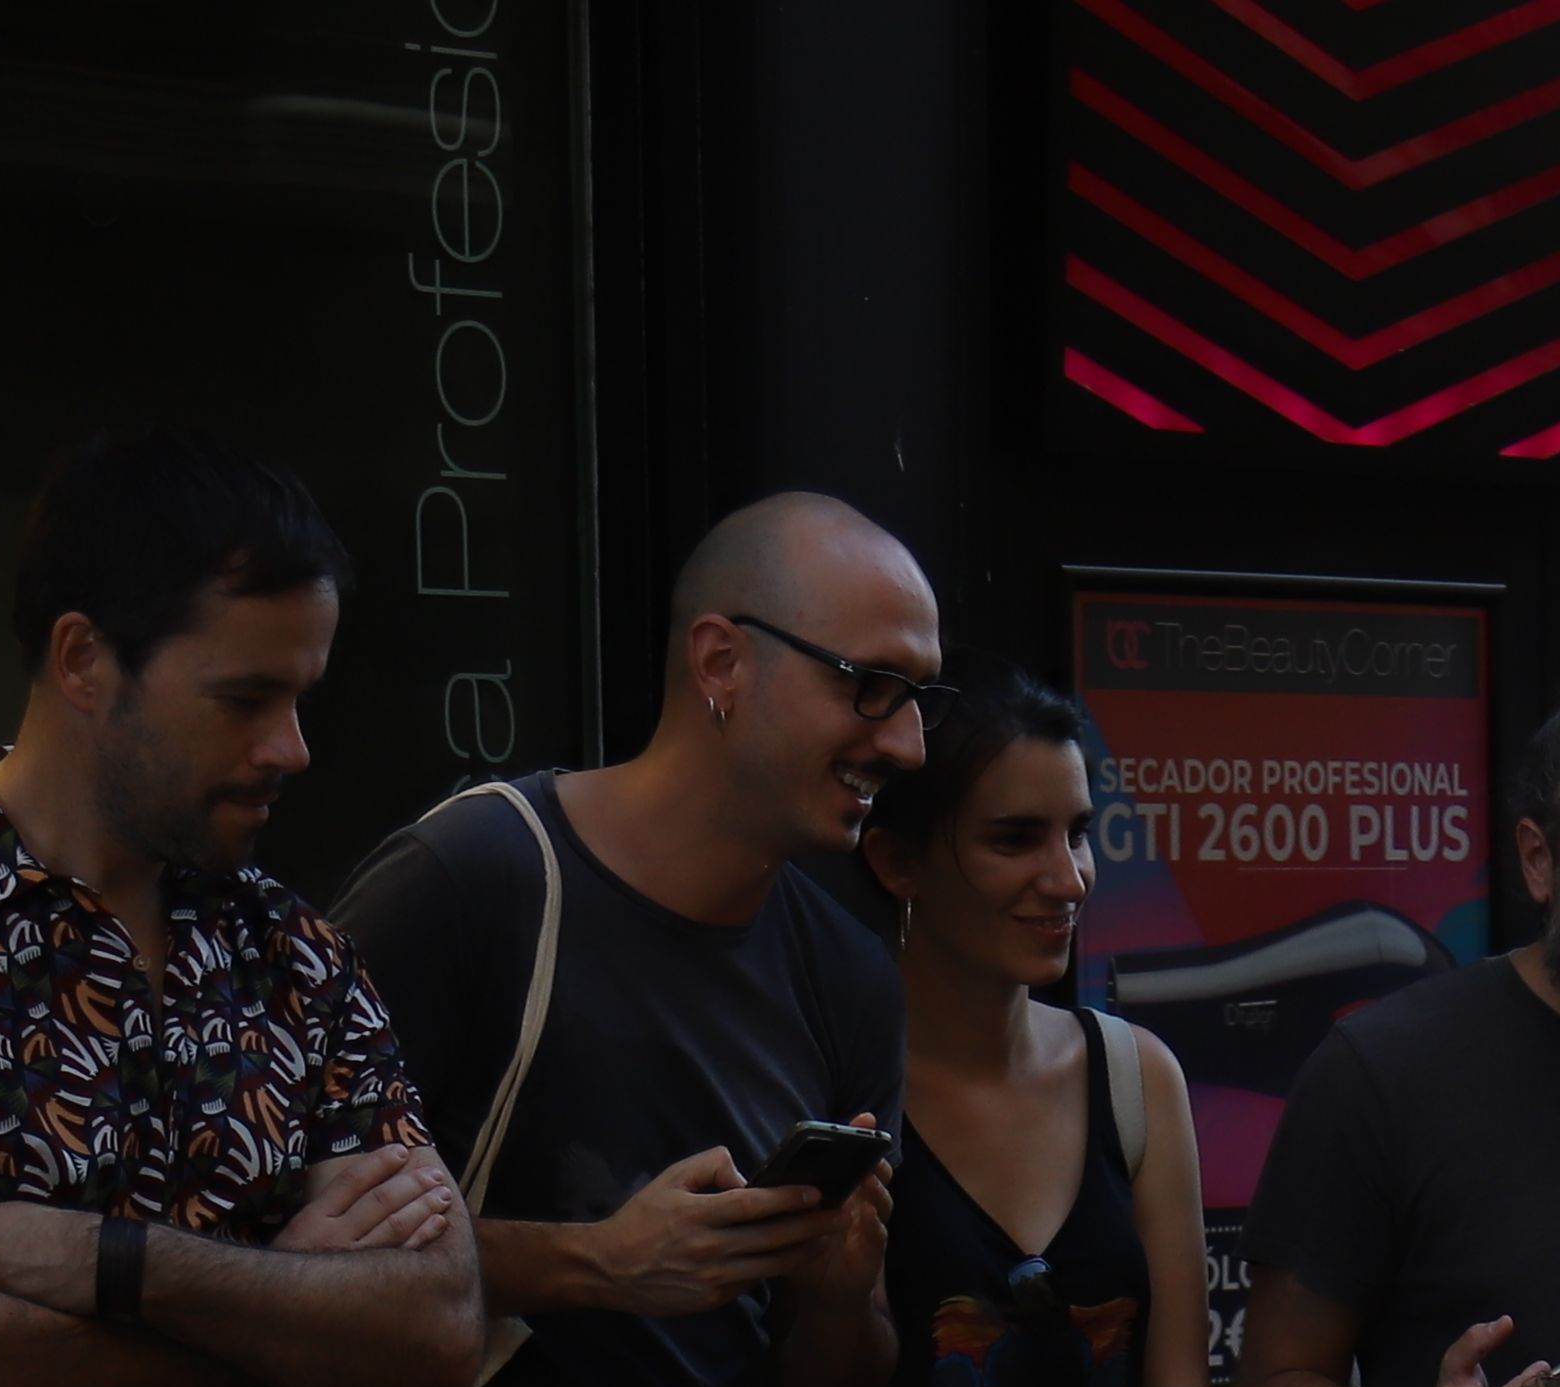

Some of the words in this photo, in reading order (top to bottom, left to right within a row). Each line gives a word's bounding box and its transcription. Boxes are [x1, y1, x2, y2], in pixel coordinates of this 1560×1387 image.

[1099, 757, 1253, 795] SECADOR
[1261, 759, 1469, 797] PROFESIONAL
[1097, 801, 1181, 863] GTI
[1196, 802, 1329, 863] 2600
[1349, 804, 1472, 863] PLUS
